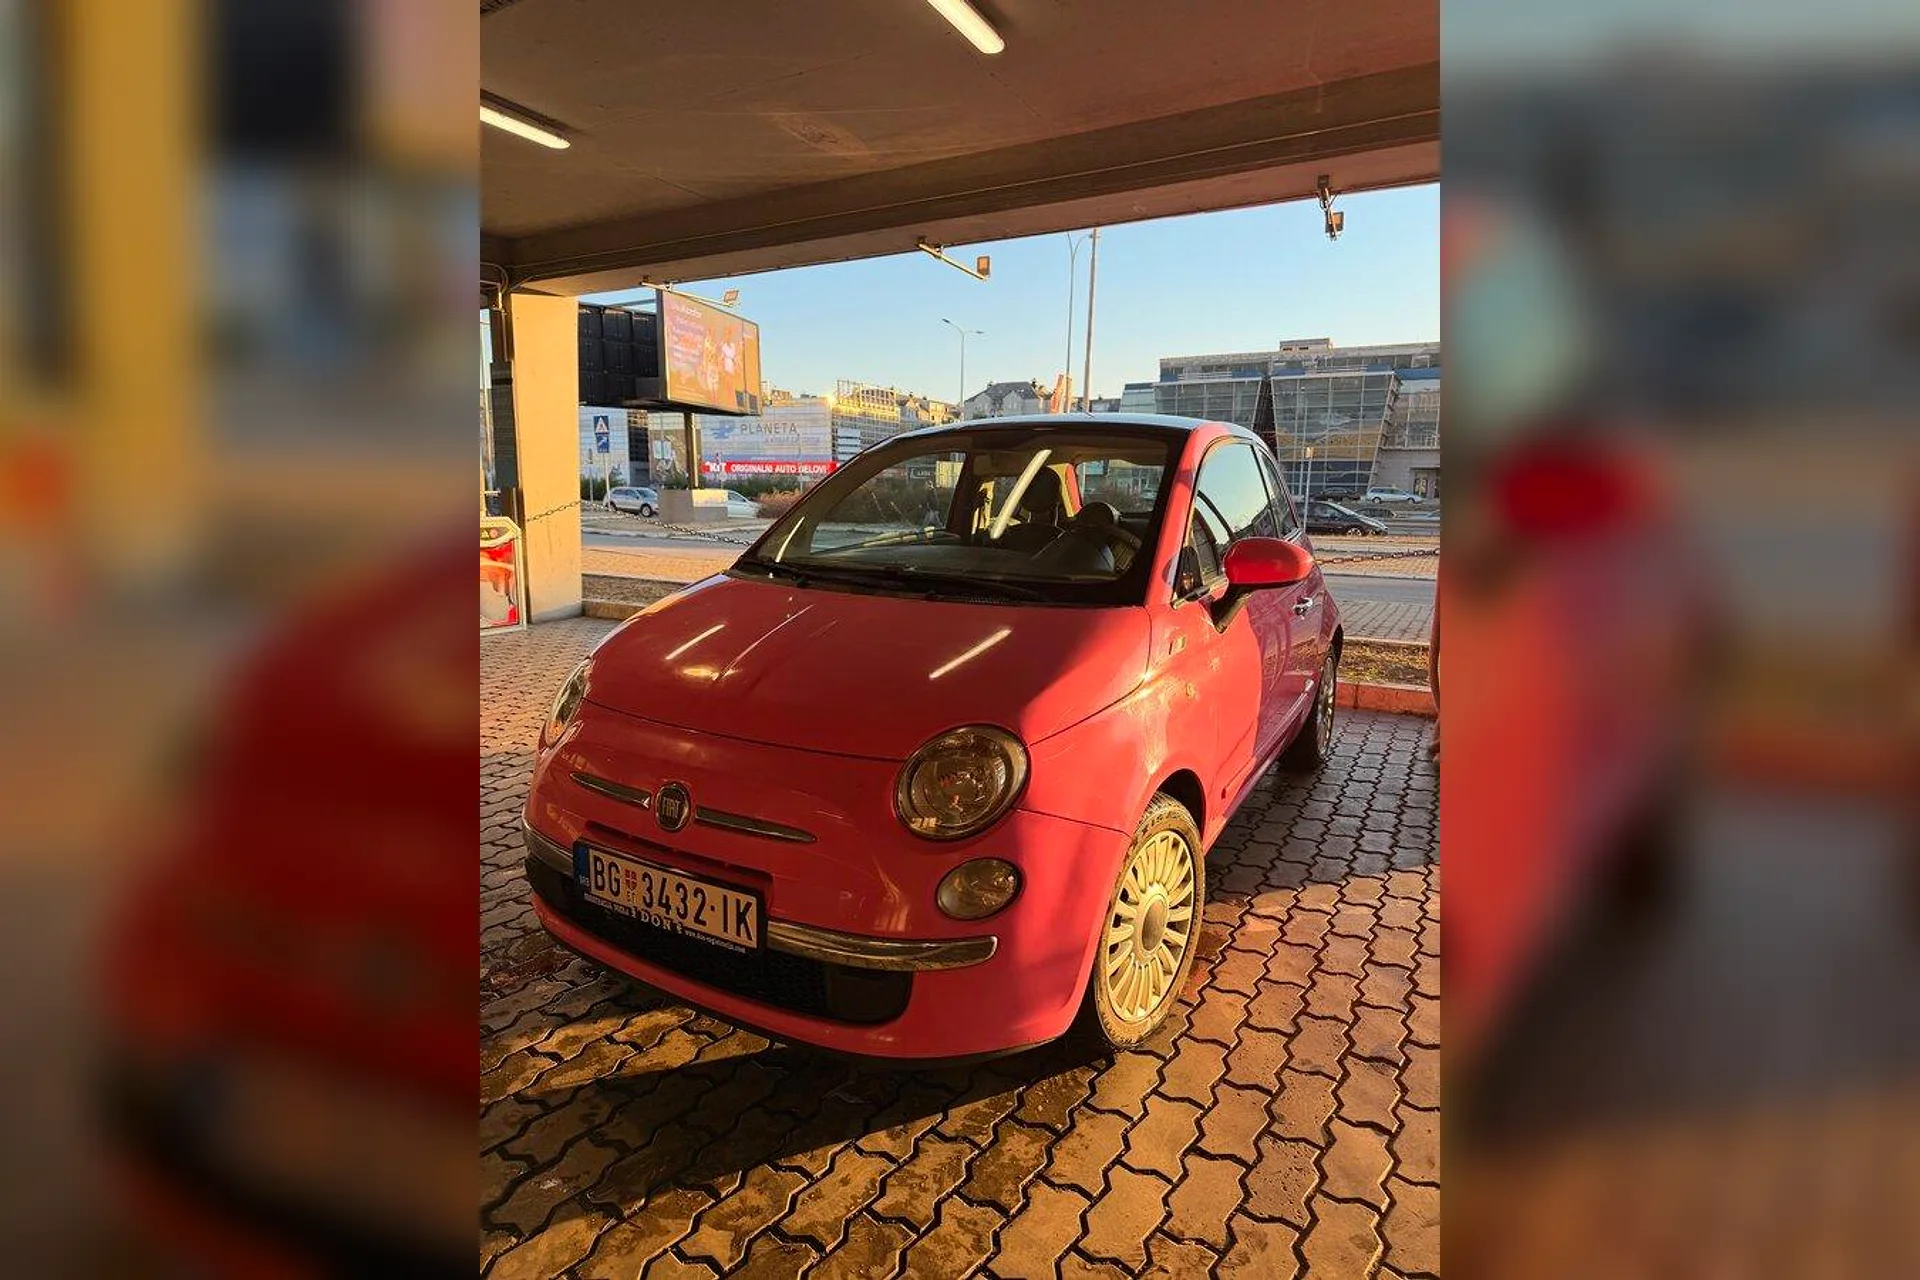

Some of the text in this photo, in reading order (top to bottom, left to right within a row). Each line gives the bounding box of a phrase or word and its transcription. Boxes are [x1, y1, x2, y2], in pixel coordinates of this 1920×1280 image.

[741, 422, 797, 435] PLANETA
[730, 463, 773, 473] ORIGINALNI
[775, 464, 796, 473] AUTO
[593, 855, 621, 897] BG
